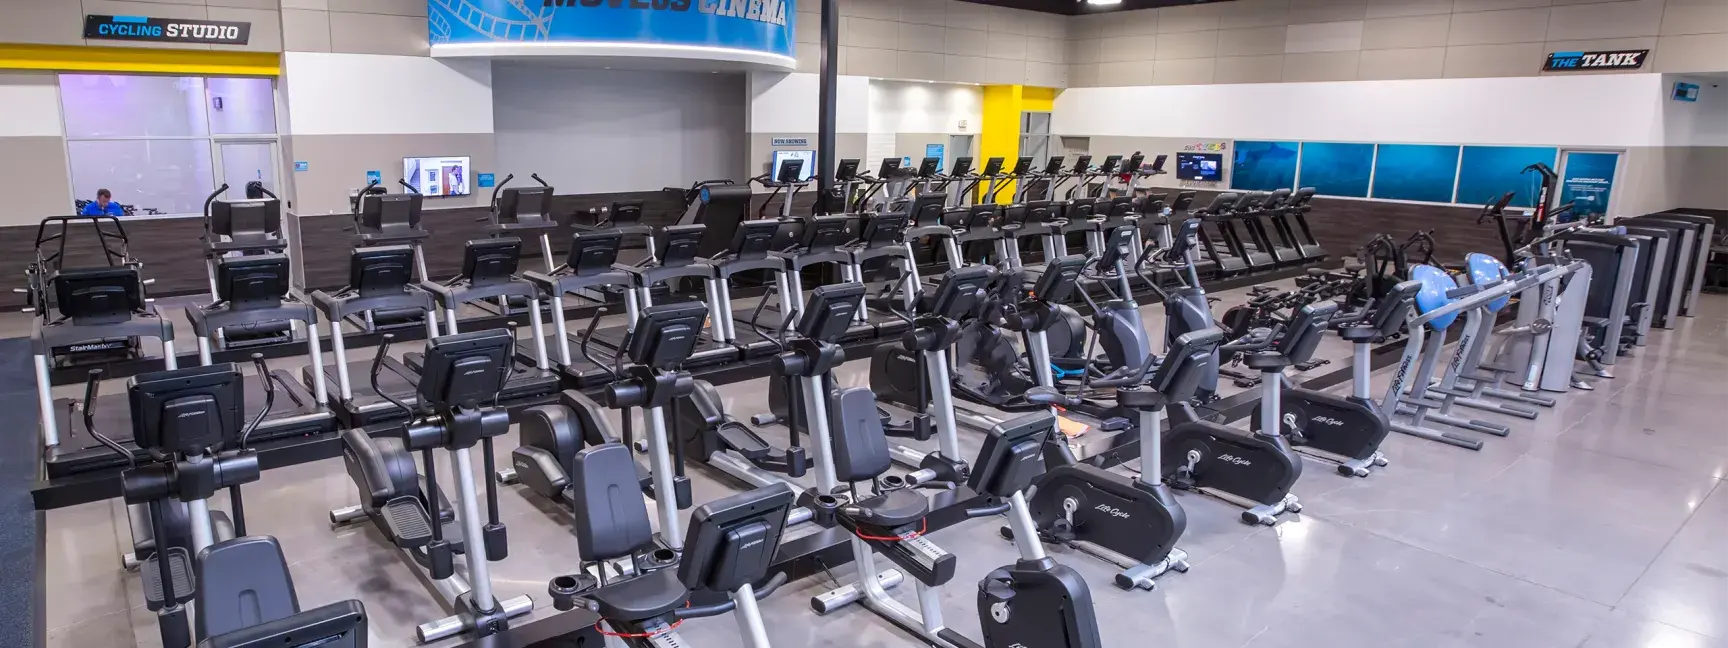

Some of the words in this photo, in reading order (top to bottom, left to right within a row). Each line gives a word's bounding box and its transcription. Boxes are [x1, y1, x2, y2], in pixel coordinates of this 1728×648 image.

[697, 0, 786, 27] CINEMA
[98, 23, 162, 37] CYCLING
[166, 23, 239, 40] STUDIO
[1552, 58, 1580, 68] THE
[1581, 52, 1641, 67] TANK
